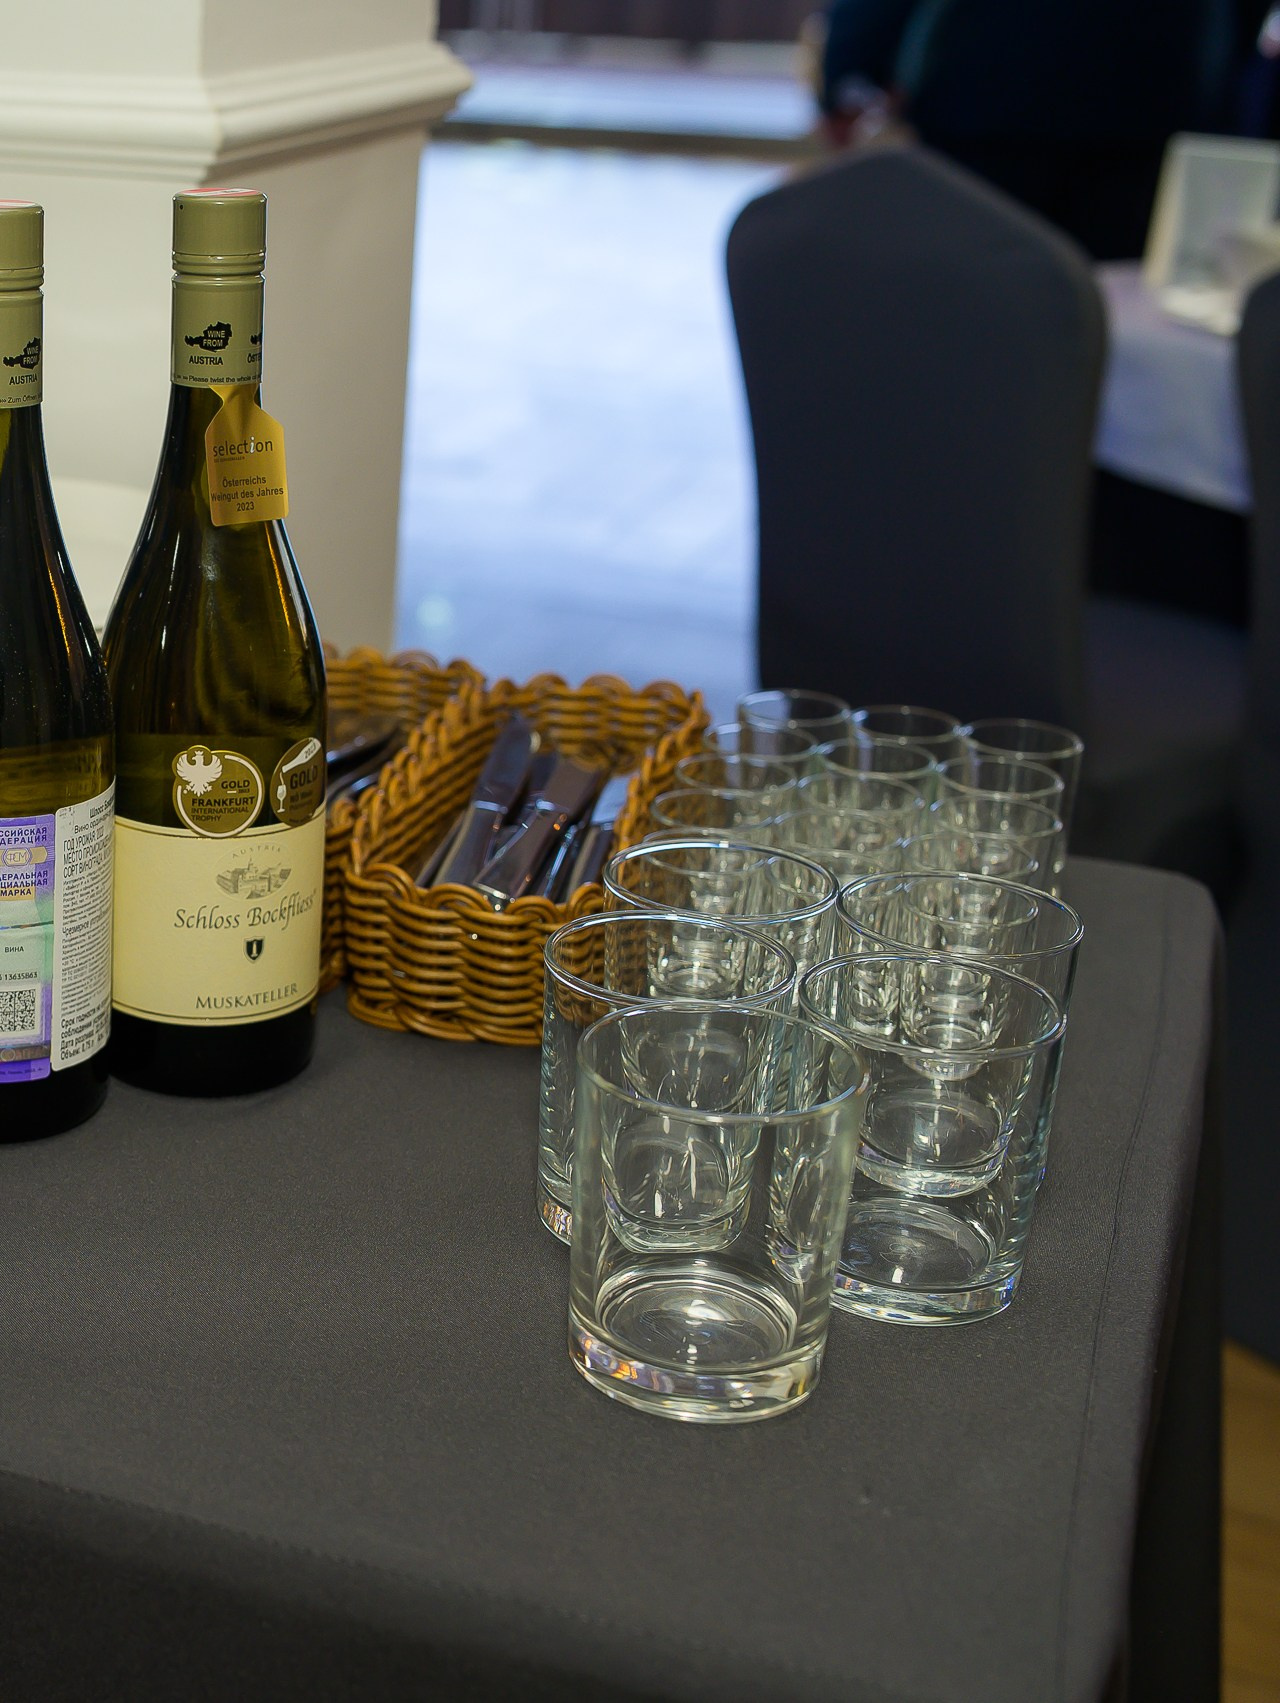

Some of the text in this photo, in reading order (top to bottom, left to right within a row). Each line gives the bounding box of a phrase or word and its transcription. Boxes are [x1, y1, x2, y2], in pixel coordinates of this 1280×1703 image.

[207, 330, 226, 338] WINE
[202, 339, 223, 347] FROM
[188, 354, 224, 366] AUSTRIA
[8, 373, 38, 386] AUSTRIA
[188, 374, 209, 383] Please
[7, 396, 22, 404] Zum
[212, 436, 273, 457] selection
[222, 475, 267, 488] Österreichs
[211, 487, 284, 502] Weingut des Jahres
[236, 501, 255, 512] 2023
[290, 765, 319, 790] GOLD
[221, 779, 250, 790] GOLD
[191, 796, 255, 807] FRANKFURT
[191, 806, 249, 815] INTERNATIONAL
[191, 814, 222, 822] TROPHY
[74, 824, 90, 835] Вино
[63, 838, 74, 852] ГОД
[63, 849, 83, 866] МЕСТО
[63, 863, 78, 878] СОРТ
[0, 888, 32, 897] МАРКА
[174, 905, 240, 930] Schloss
[195, 982, 298, 1009] MUSKATELLER
[60, 1017, 75, 1030] Срок
[60, 1038, 74, 1052] Дата
